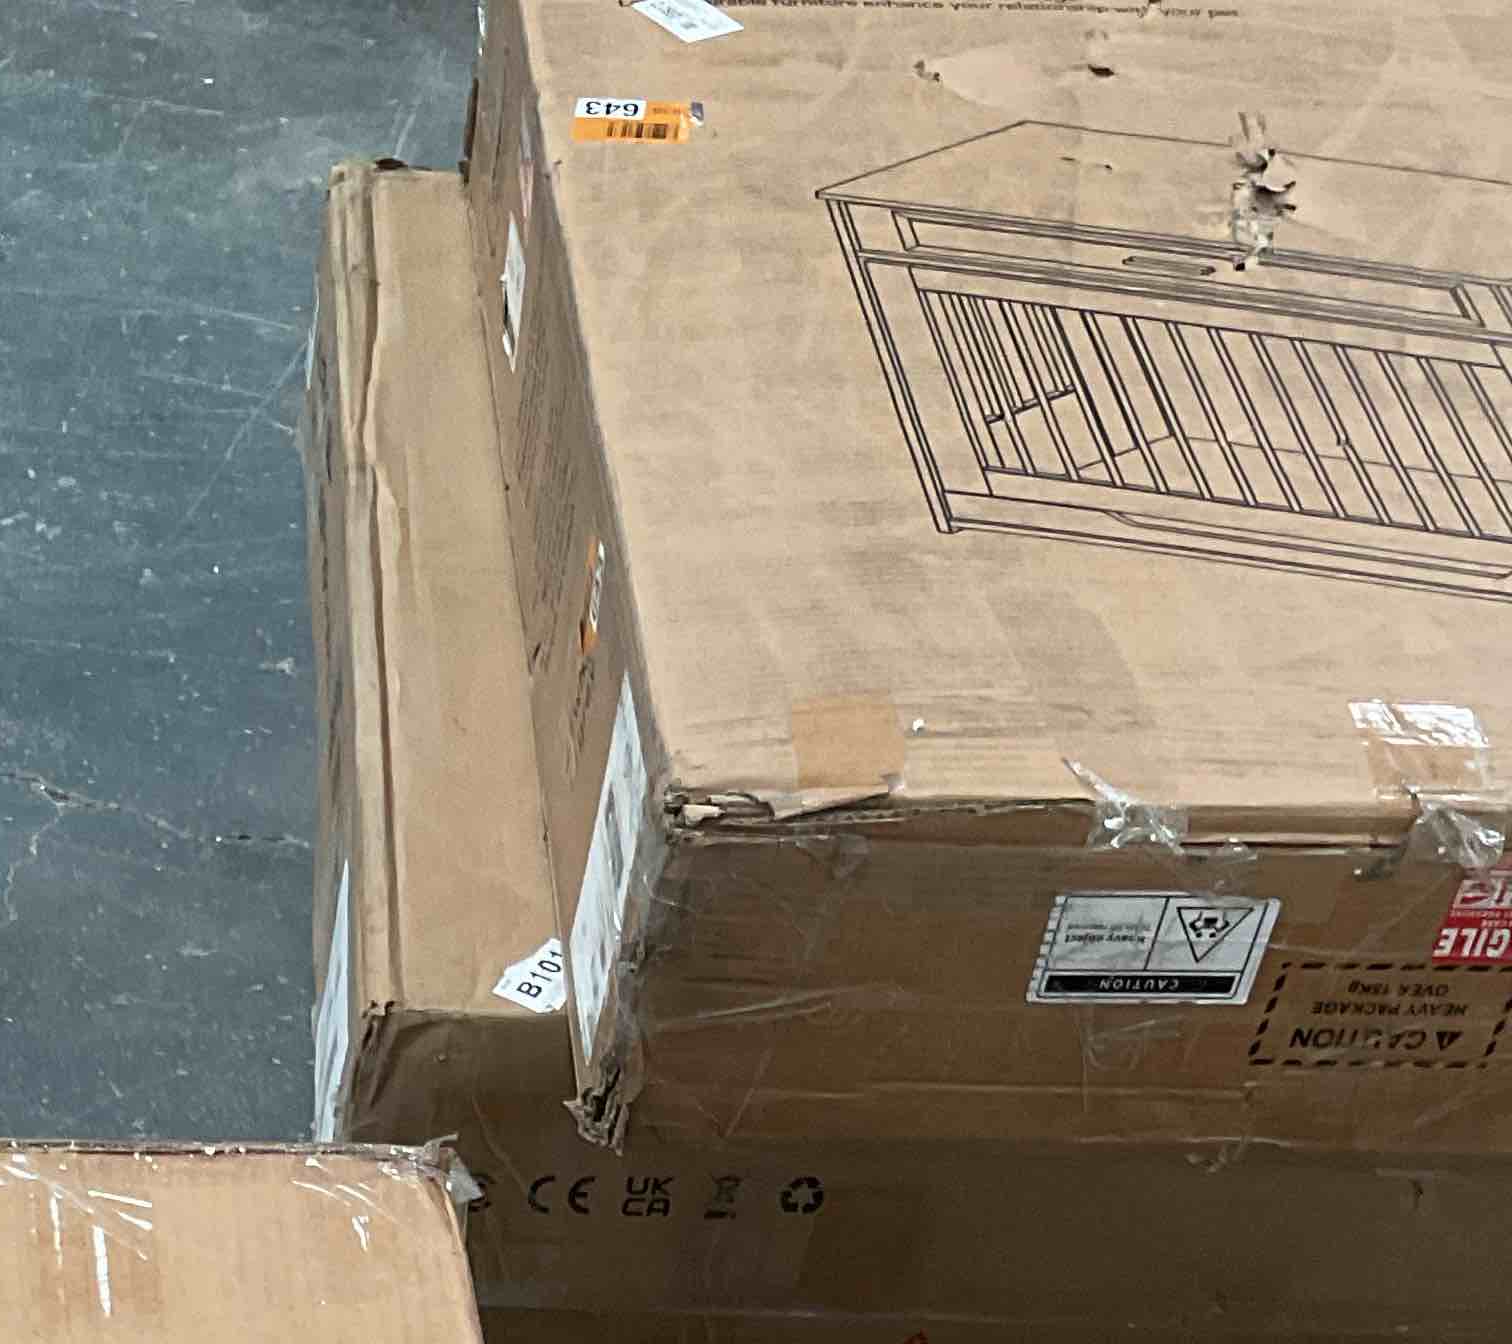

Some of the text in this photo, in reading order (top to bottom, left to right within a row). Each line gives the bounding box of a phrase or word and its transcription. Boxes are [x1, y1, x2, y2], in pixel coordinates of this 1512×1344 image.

[1432, 927, 1511, 958] GILE
[1098, 978, 1179, 991] CAUTION
[1310, 1001, 1468, 1017] HEAVY PACKAGE
